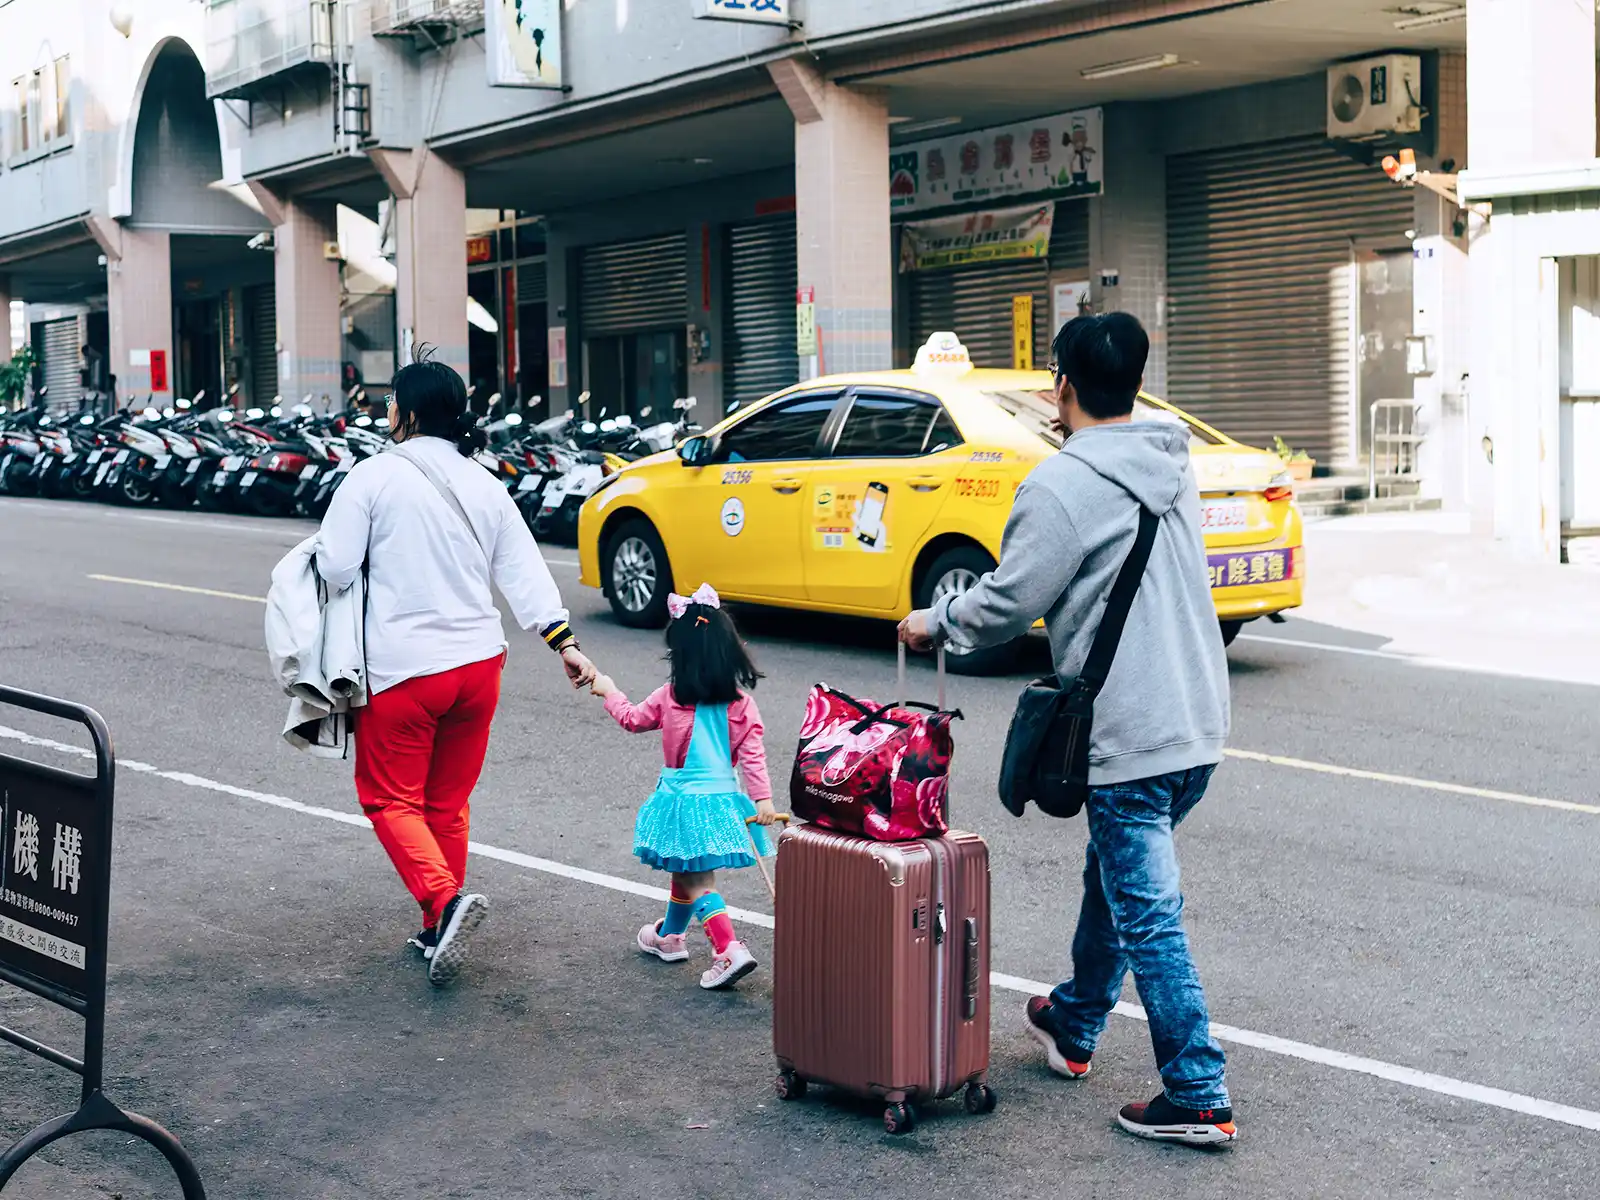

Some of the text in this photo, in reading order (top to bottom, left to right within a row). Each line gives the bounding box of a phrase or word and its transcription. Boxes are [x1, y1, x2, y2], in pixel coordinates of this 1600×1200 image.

[969, 451, 1004, 463] 25356
[721, 470, 754, 485] 25356
[12, 810, 82, 894] 機構
